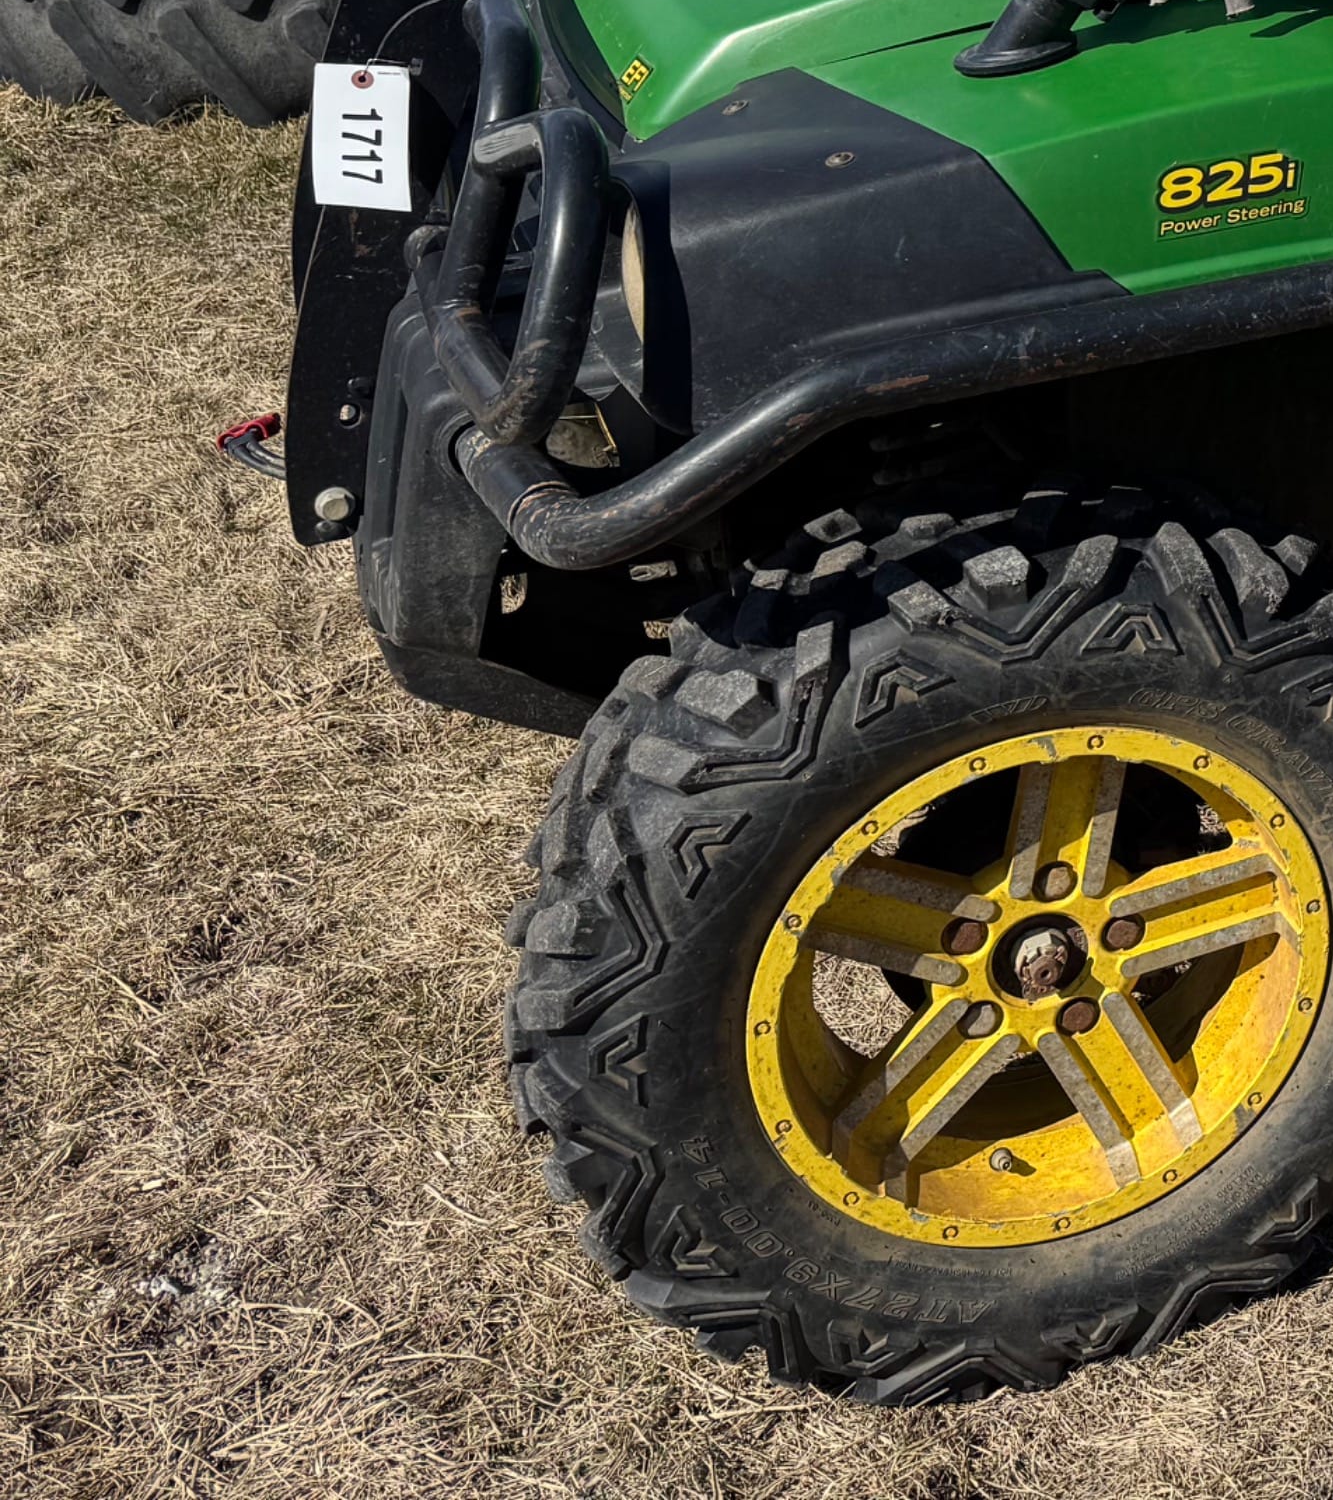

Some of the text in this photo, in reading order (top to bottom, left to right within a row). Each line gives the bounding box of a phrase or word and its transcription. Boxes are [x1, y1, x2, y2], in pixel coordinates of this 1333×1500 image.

[341, 108, 383, 184] 1717
[1159, 152, 1296, 209] 825i
[1159, 199, 1305, 236] Power Steering
